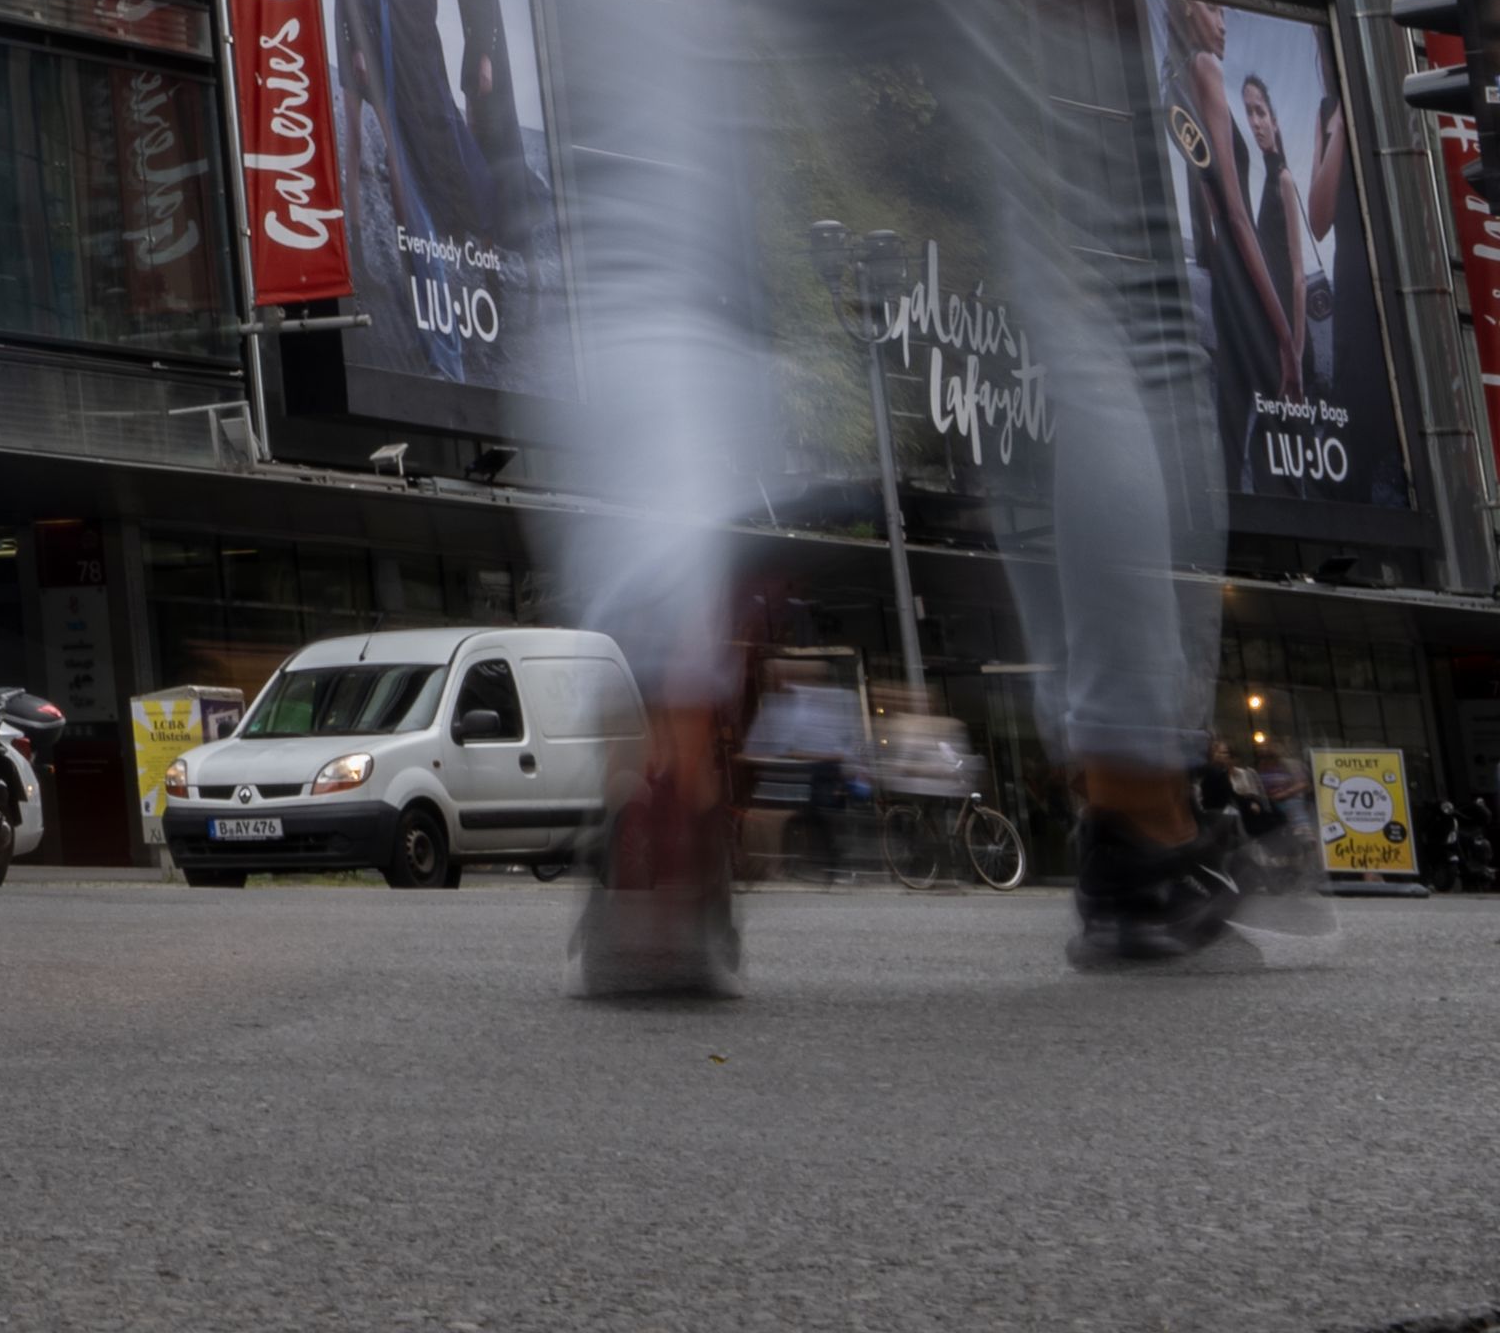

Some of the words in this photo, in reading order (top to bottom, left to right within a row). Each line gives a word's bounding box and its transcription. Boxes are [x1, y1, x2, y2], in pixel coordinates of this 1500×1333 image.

[243, 18, 344, 249] Galeries
[397, 225, 462, 270] Everybody
[464, 241, 501, 271] Coats
[930, 330, 1056, 466] Lafayett
[1254, 391, 1317, 425] Everybody
[1319, 399, 1349, 428] Bags
[76, 560, 102, 582] 78
[150, 731, 191, 742] Ullstein
[1335, 759, 1379, 768] OUTLET
[253, 821, 277, 834] 476
